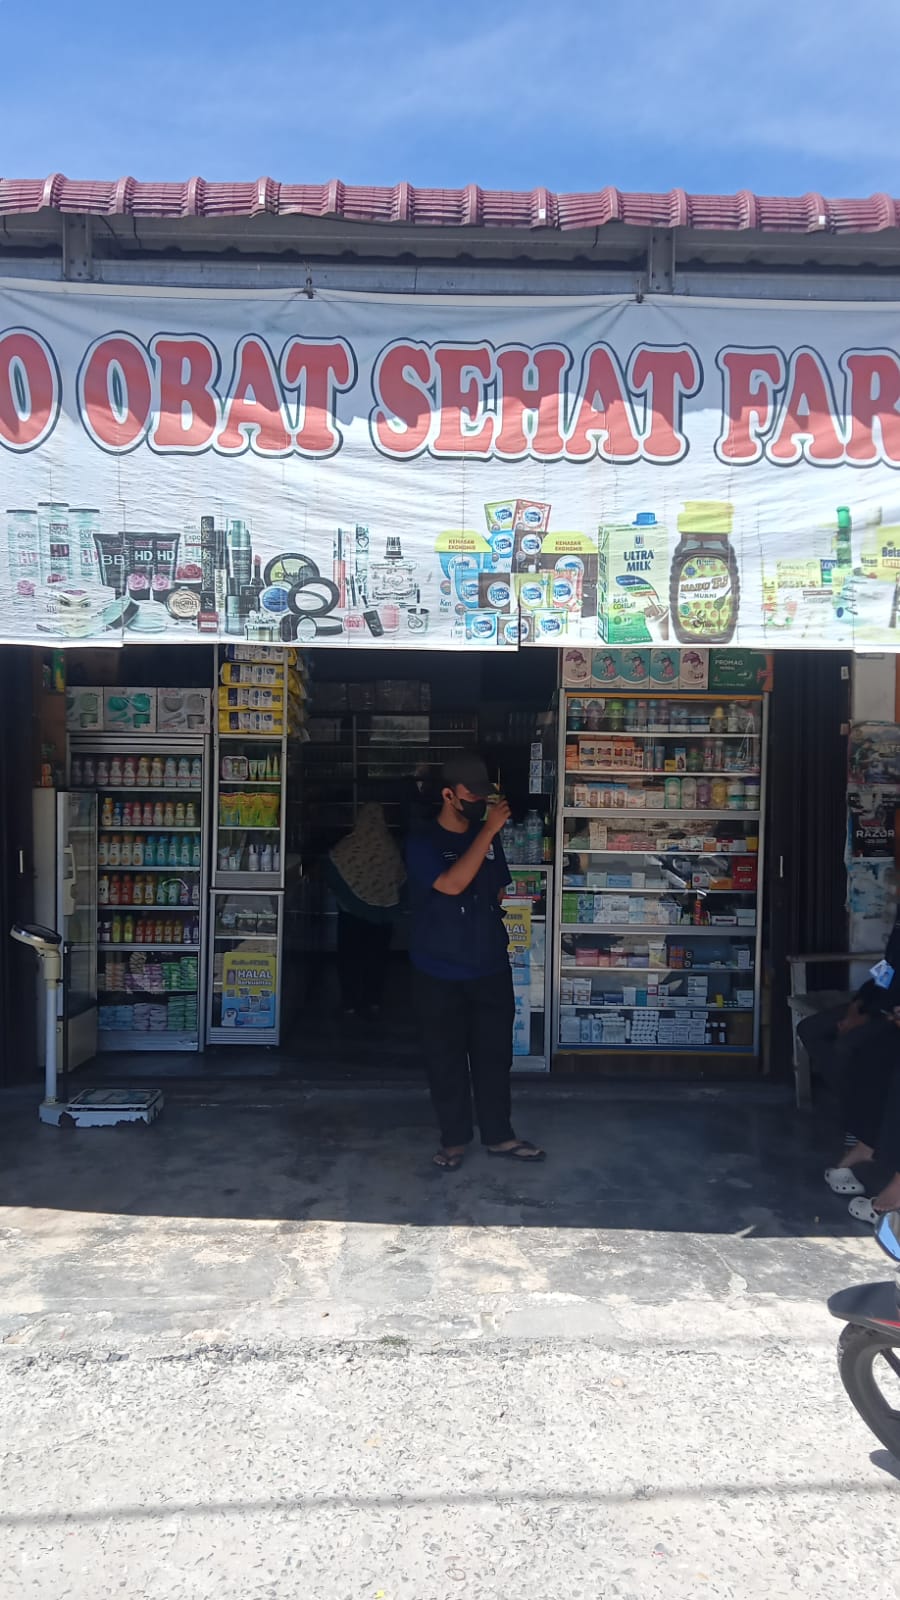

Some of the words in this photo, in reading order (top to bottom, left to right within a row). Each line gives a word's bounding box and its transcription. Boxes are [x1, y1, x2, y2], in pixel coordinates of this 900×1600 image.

[76, 330, 359, 460] OBAT
[370, 337, 704, 464] SEHAT
[714, 344, 900, 467] FAR
[102, 554, 125, 565] BB
[134, 550, 153, 561] HD
[157, 550, 176, 561] HD
[623, 550, 655, 561] ULTRA
[626, 561, 652, 572] MILK
[680, 582, 711, 592] MADU
[856, 829, 895, 838] RAZOR
[506, 925, 527, 934] LAL
[238, 969, 273, 979] HALAL
